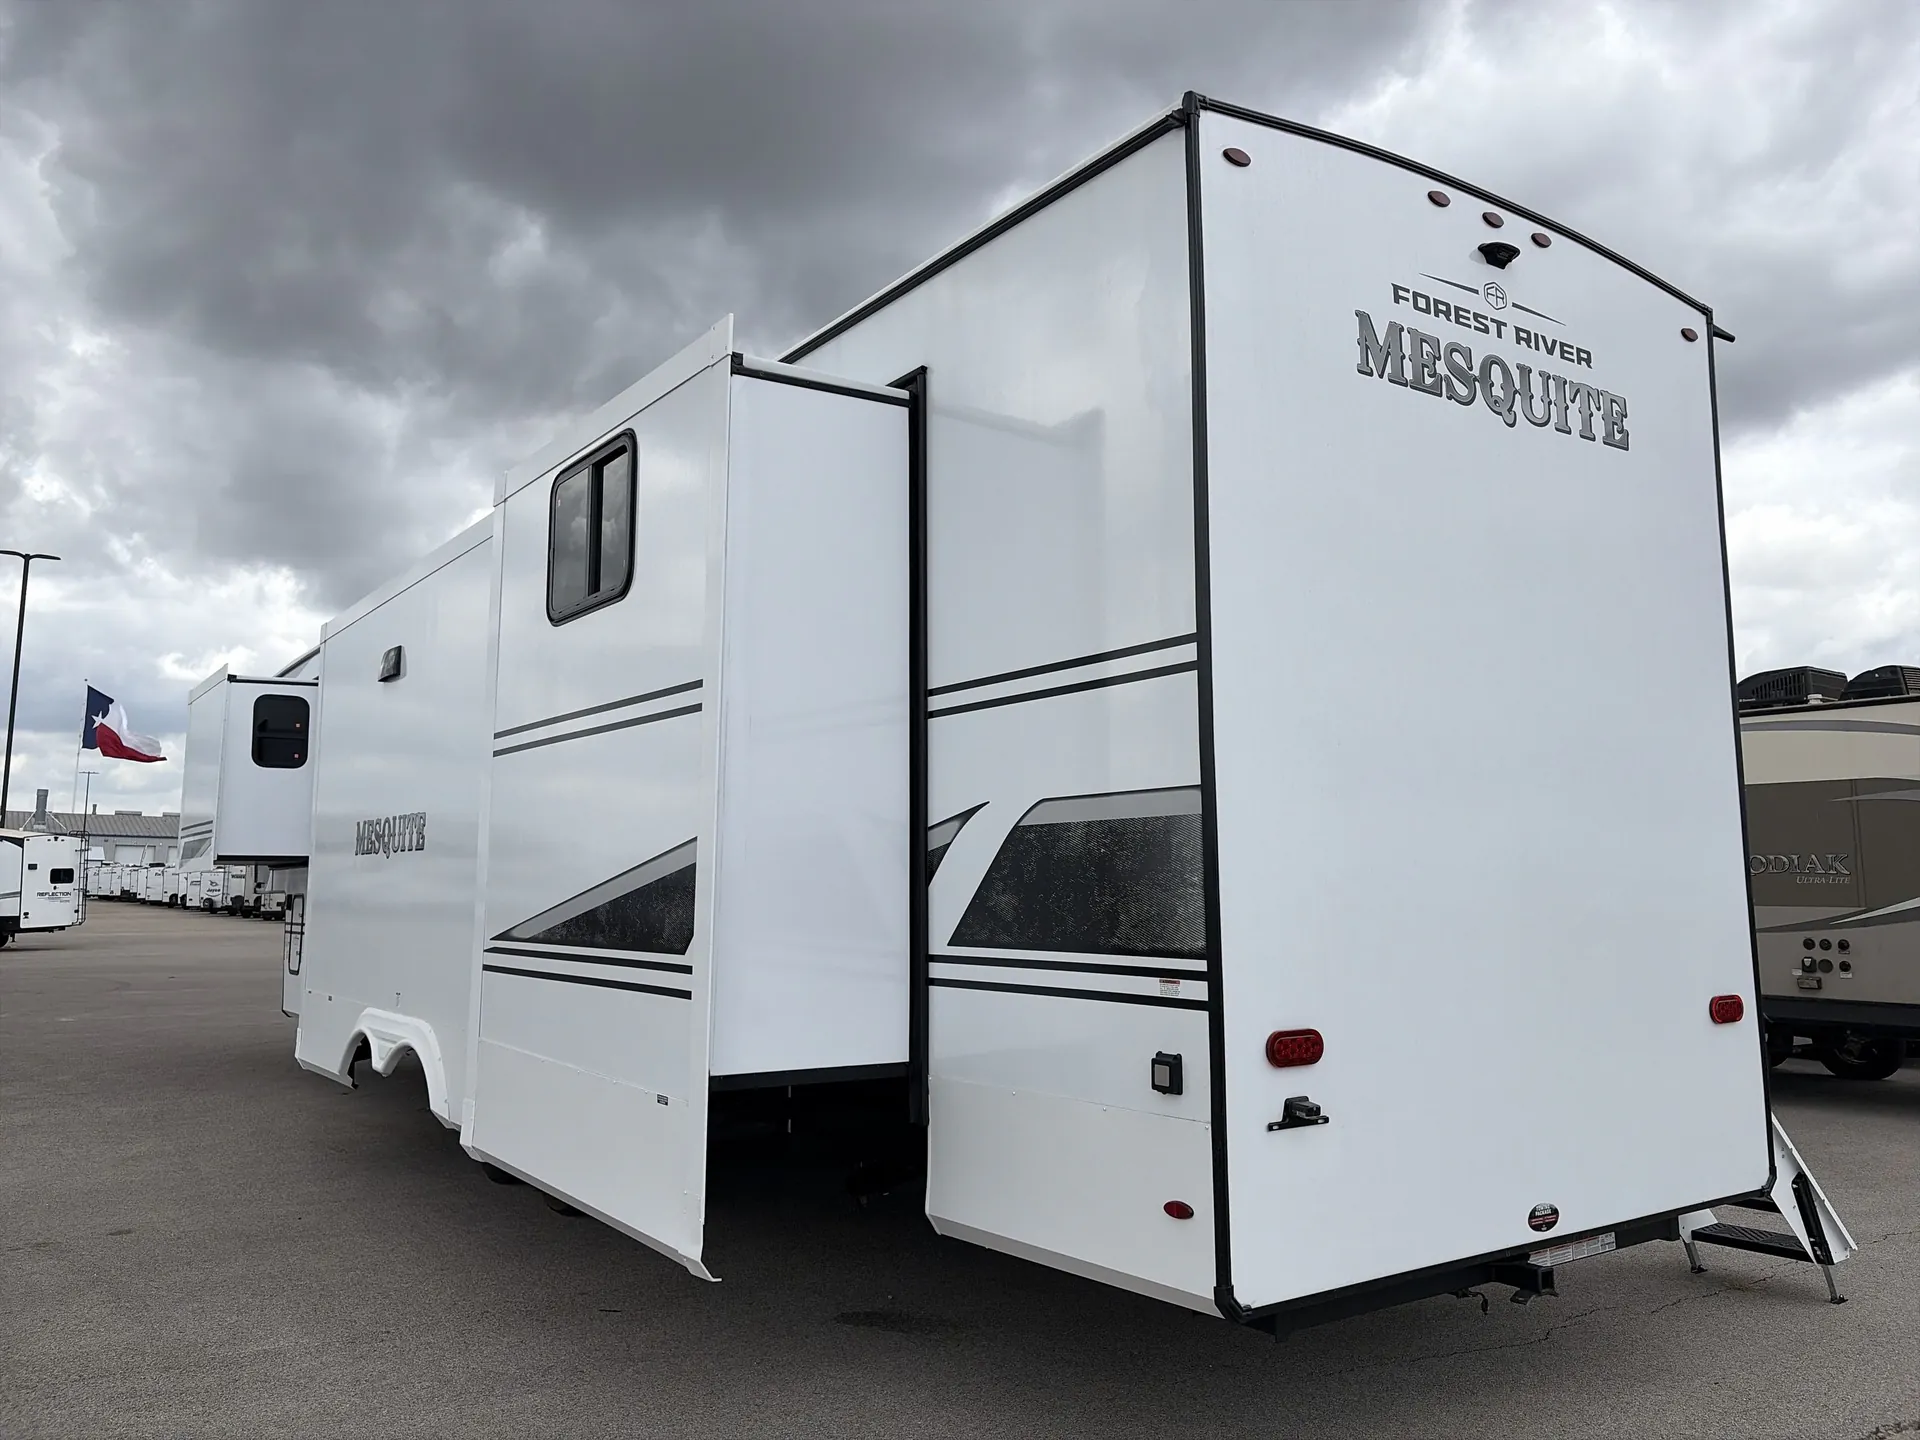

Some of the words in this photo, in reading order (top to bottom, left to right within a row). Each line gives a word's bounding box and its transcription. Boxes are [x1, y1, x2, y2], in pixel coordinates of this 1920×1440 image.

[1391, 282, 1507, 339] FOREST
[1513, 325, 1593, 369] RIVER
[1355, 310, 1630, 451] MESQUITE
[355, 812, 426, 859] MESQUITE
[1750, 854, 1851, 875] ODIAK
